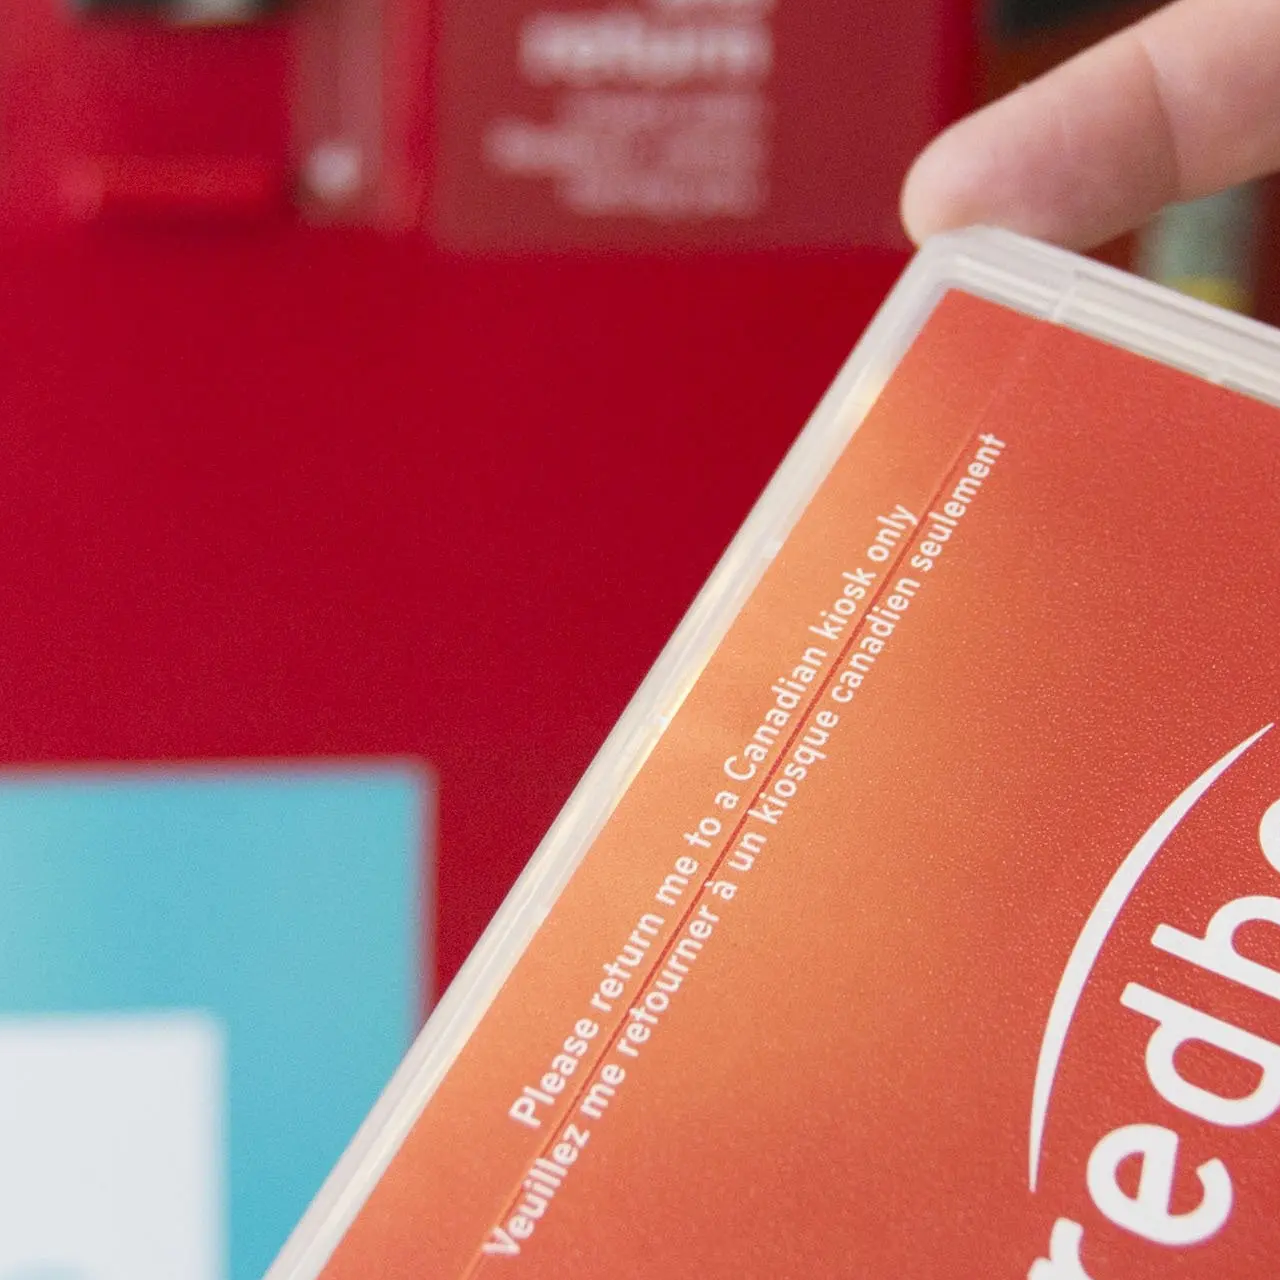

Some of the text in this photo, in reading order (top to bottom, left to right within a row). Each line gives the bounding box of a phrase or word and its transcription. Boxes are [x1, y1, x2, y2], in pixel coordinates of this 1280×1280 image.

[481, 432, 1006, 1257] Veuillez me retourner à un kiosque canadien seulement
[509, 504, 919, 1128] Please return me to a Canadian kiosk only
